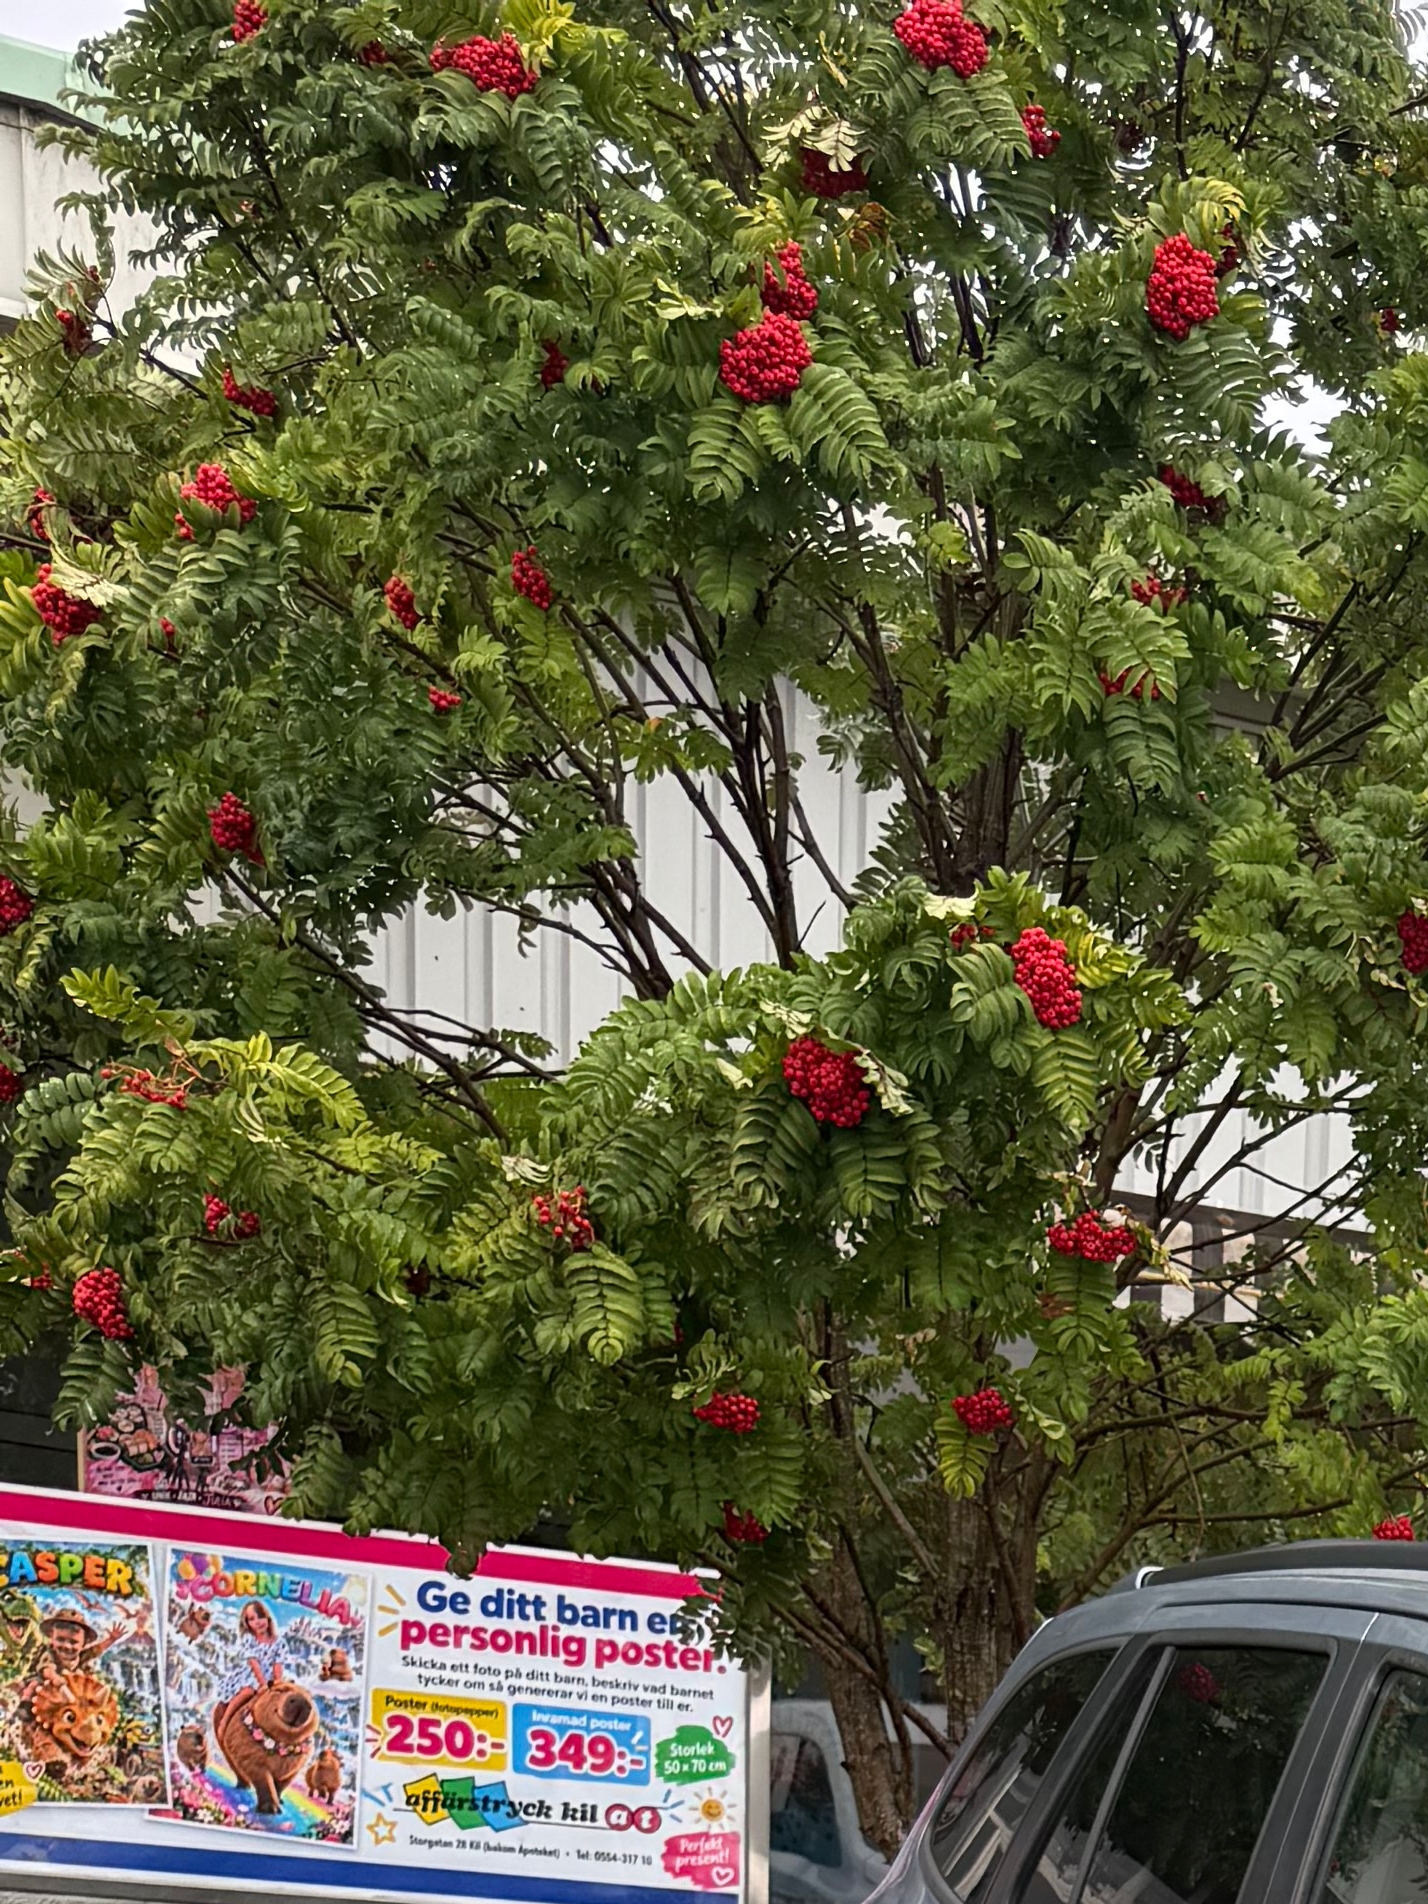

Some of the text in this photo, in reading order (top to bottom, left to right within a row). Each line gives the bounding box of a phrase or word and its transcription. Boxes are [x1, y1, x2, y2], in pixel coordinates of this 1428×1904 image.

[189, 1569, 351, 1626] CORNELIA
[417, 1580, 471, 1615] Ge
[480, 1588, 547, 1622] ditt
[557, 1594, 639, 1632] barn
[400, 1619, 727, 1675] personlig poster.
[401, 1655, 715, 1700] Skicka ett foto på ditt barn, beskriv vad barnet
[416, 1673, 694, 1713] tycker om så genererar vi en poster till er.
[385, 1695, 428, 1711] Poster
[532, 1709, 632, 1731] Inramad poster
[386, 1714, 505, 1759] 250:-
[529, 1729, 644, 1775] 349:-
[670, 1740, 716, 1757] Storlek
[664, 1759, 680, 1775] 50
[691, 1758, 707, 1773] 70
[708, 1760, 727, 1772] cm
[561, 1801, 598, 1823] kil
[675, 1847, 730, 1873] present!
